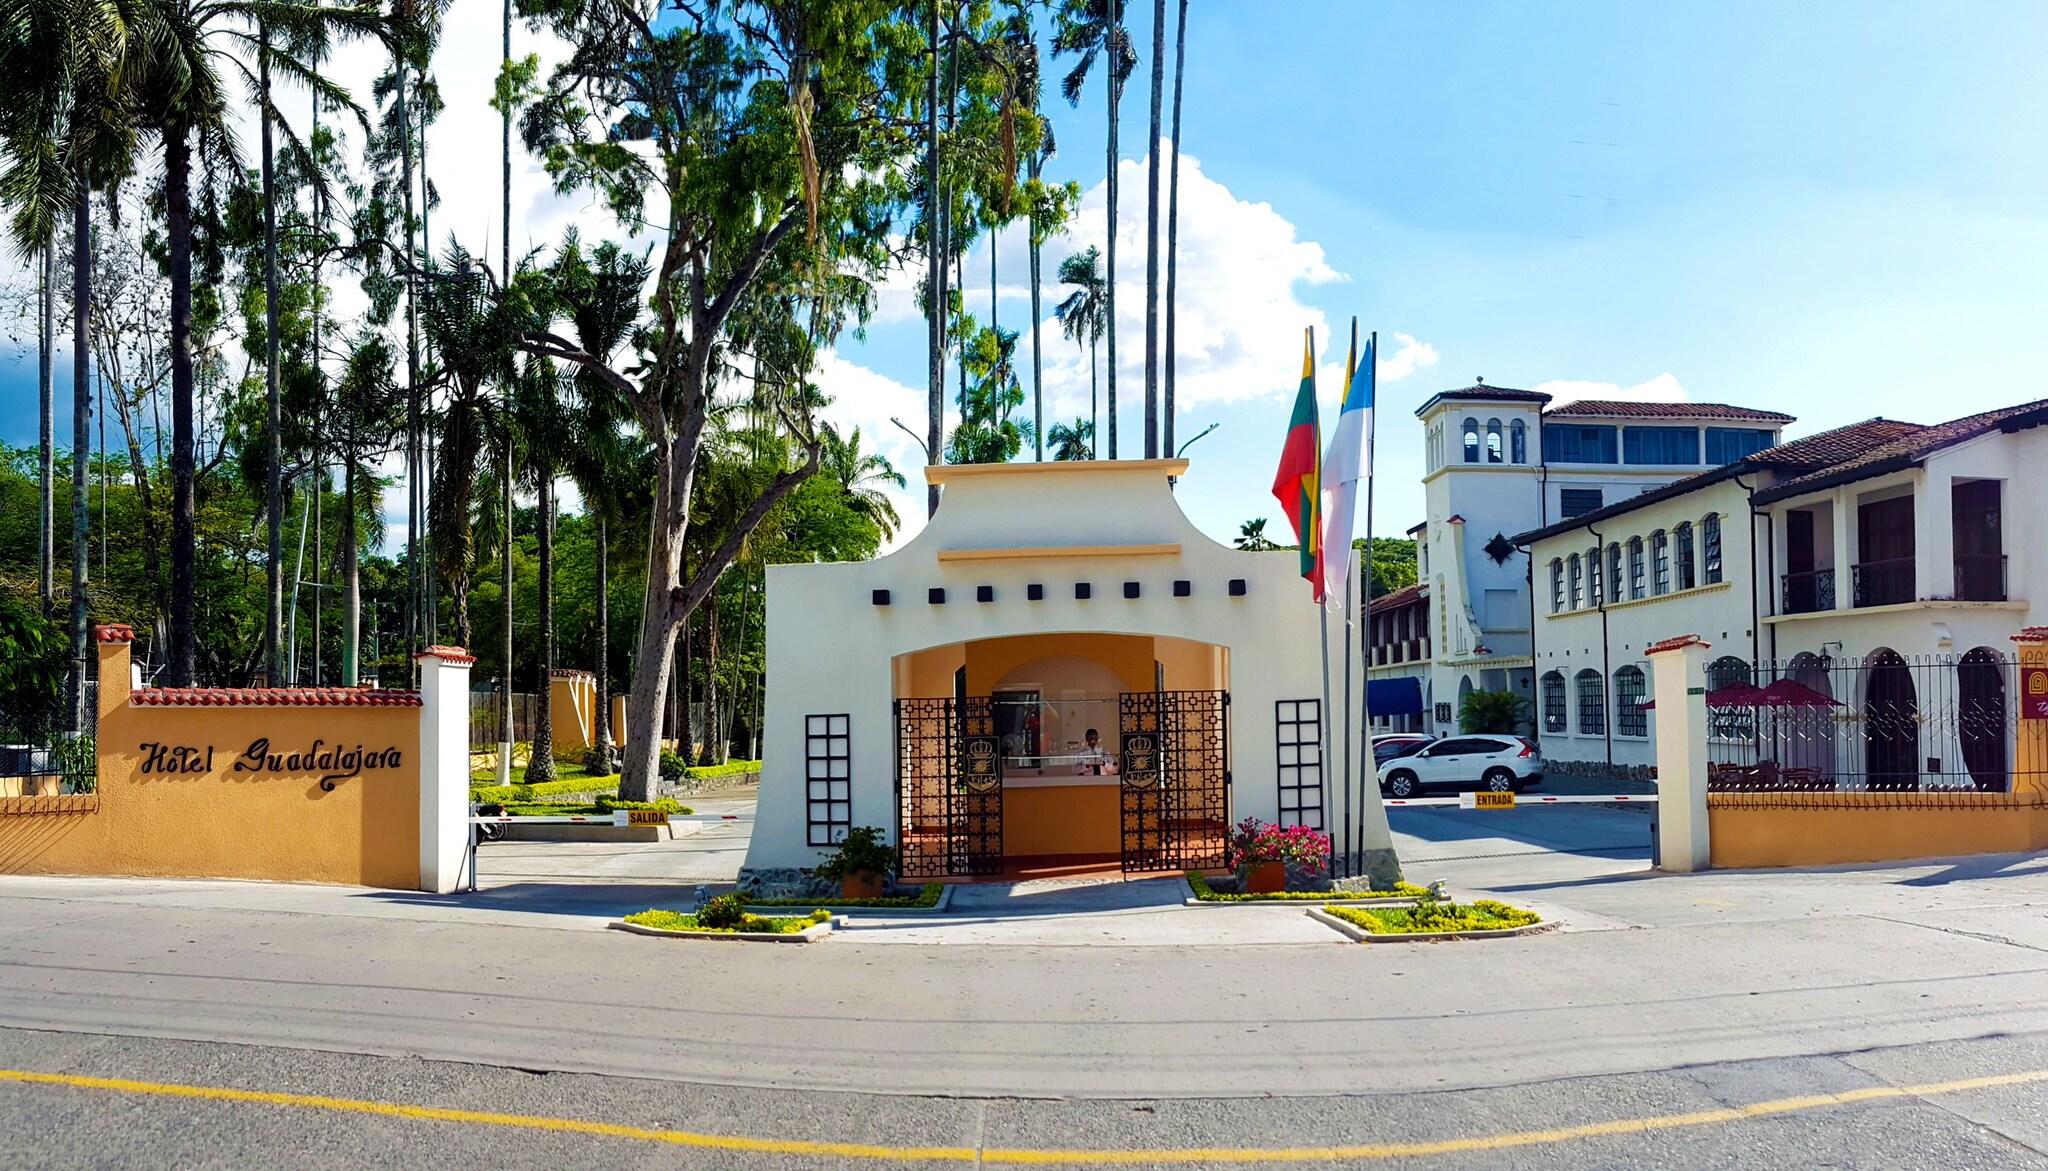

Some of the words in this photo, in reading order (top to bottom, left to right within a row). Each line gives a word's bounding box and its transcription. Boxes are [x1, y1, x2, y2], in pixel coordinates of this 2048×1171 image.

[233, 738, 402, 792] Guadalajara
[1477, 794, 1513, 806] ENTRADA
[630, 812, 666, 824] SALIDA
